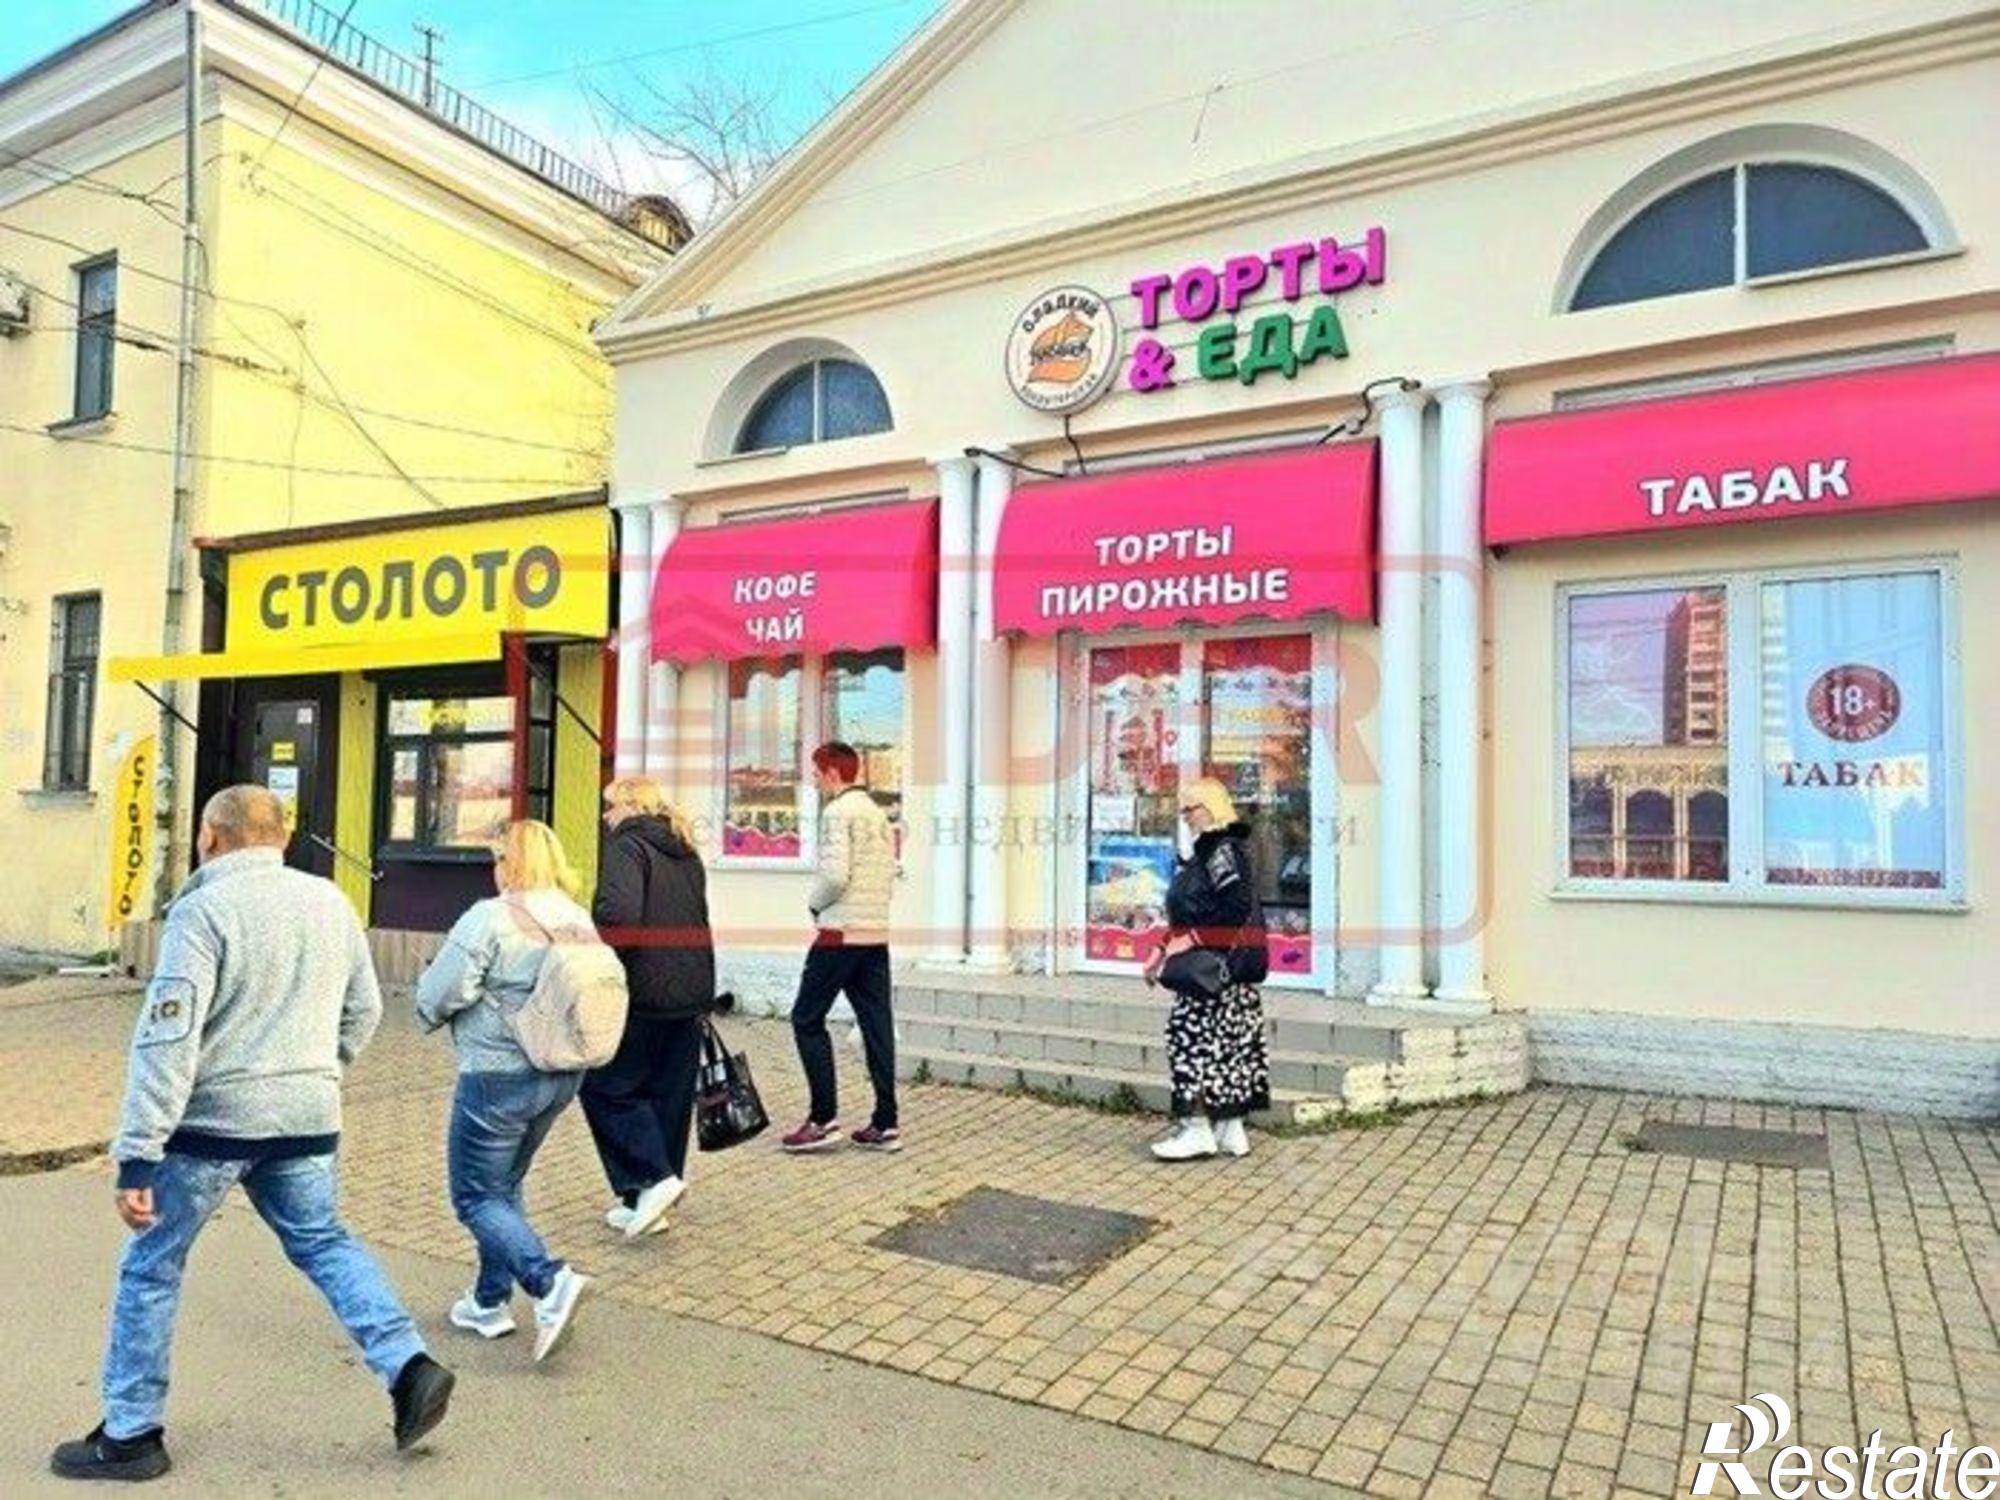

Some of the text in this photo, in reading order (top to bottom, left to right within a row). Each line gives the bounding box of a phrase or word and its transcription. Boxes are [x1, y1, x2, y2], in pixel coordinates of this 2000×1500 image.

[1131, 226, 1386, 329] ТОРТЫ
[1130, 338, 1176, 392] &
[1198, 305, 1349, 386] ЕДА
[1639, 458, 1850, 516] ТАБАК
[1094, 524, 1234, 567] ТОРТЫ
[260, 544, 562, 630] СТОЛОТО
[733, 570, 817, 604] КОФЕ
[1041, 567, 1290, 618] ПИРОЖНЫЕ
[744, 607, 804, 644] ЧАЙ
[1830, 684, 1877, 716] 18+
[1778, 760, 1923, 788] ТАБАК
[118, 755, 144, 916] СТОЛОТО
